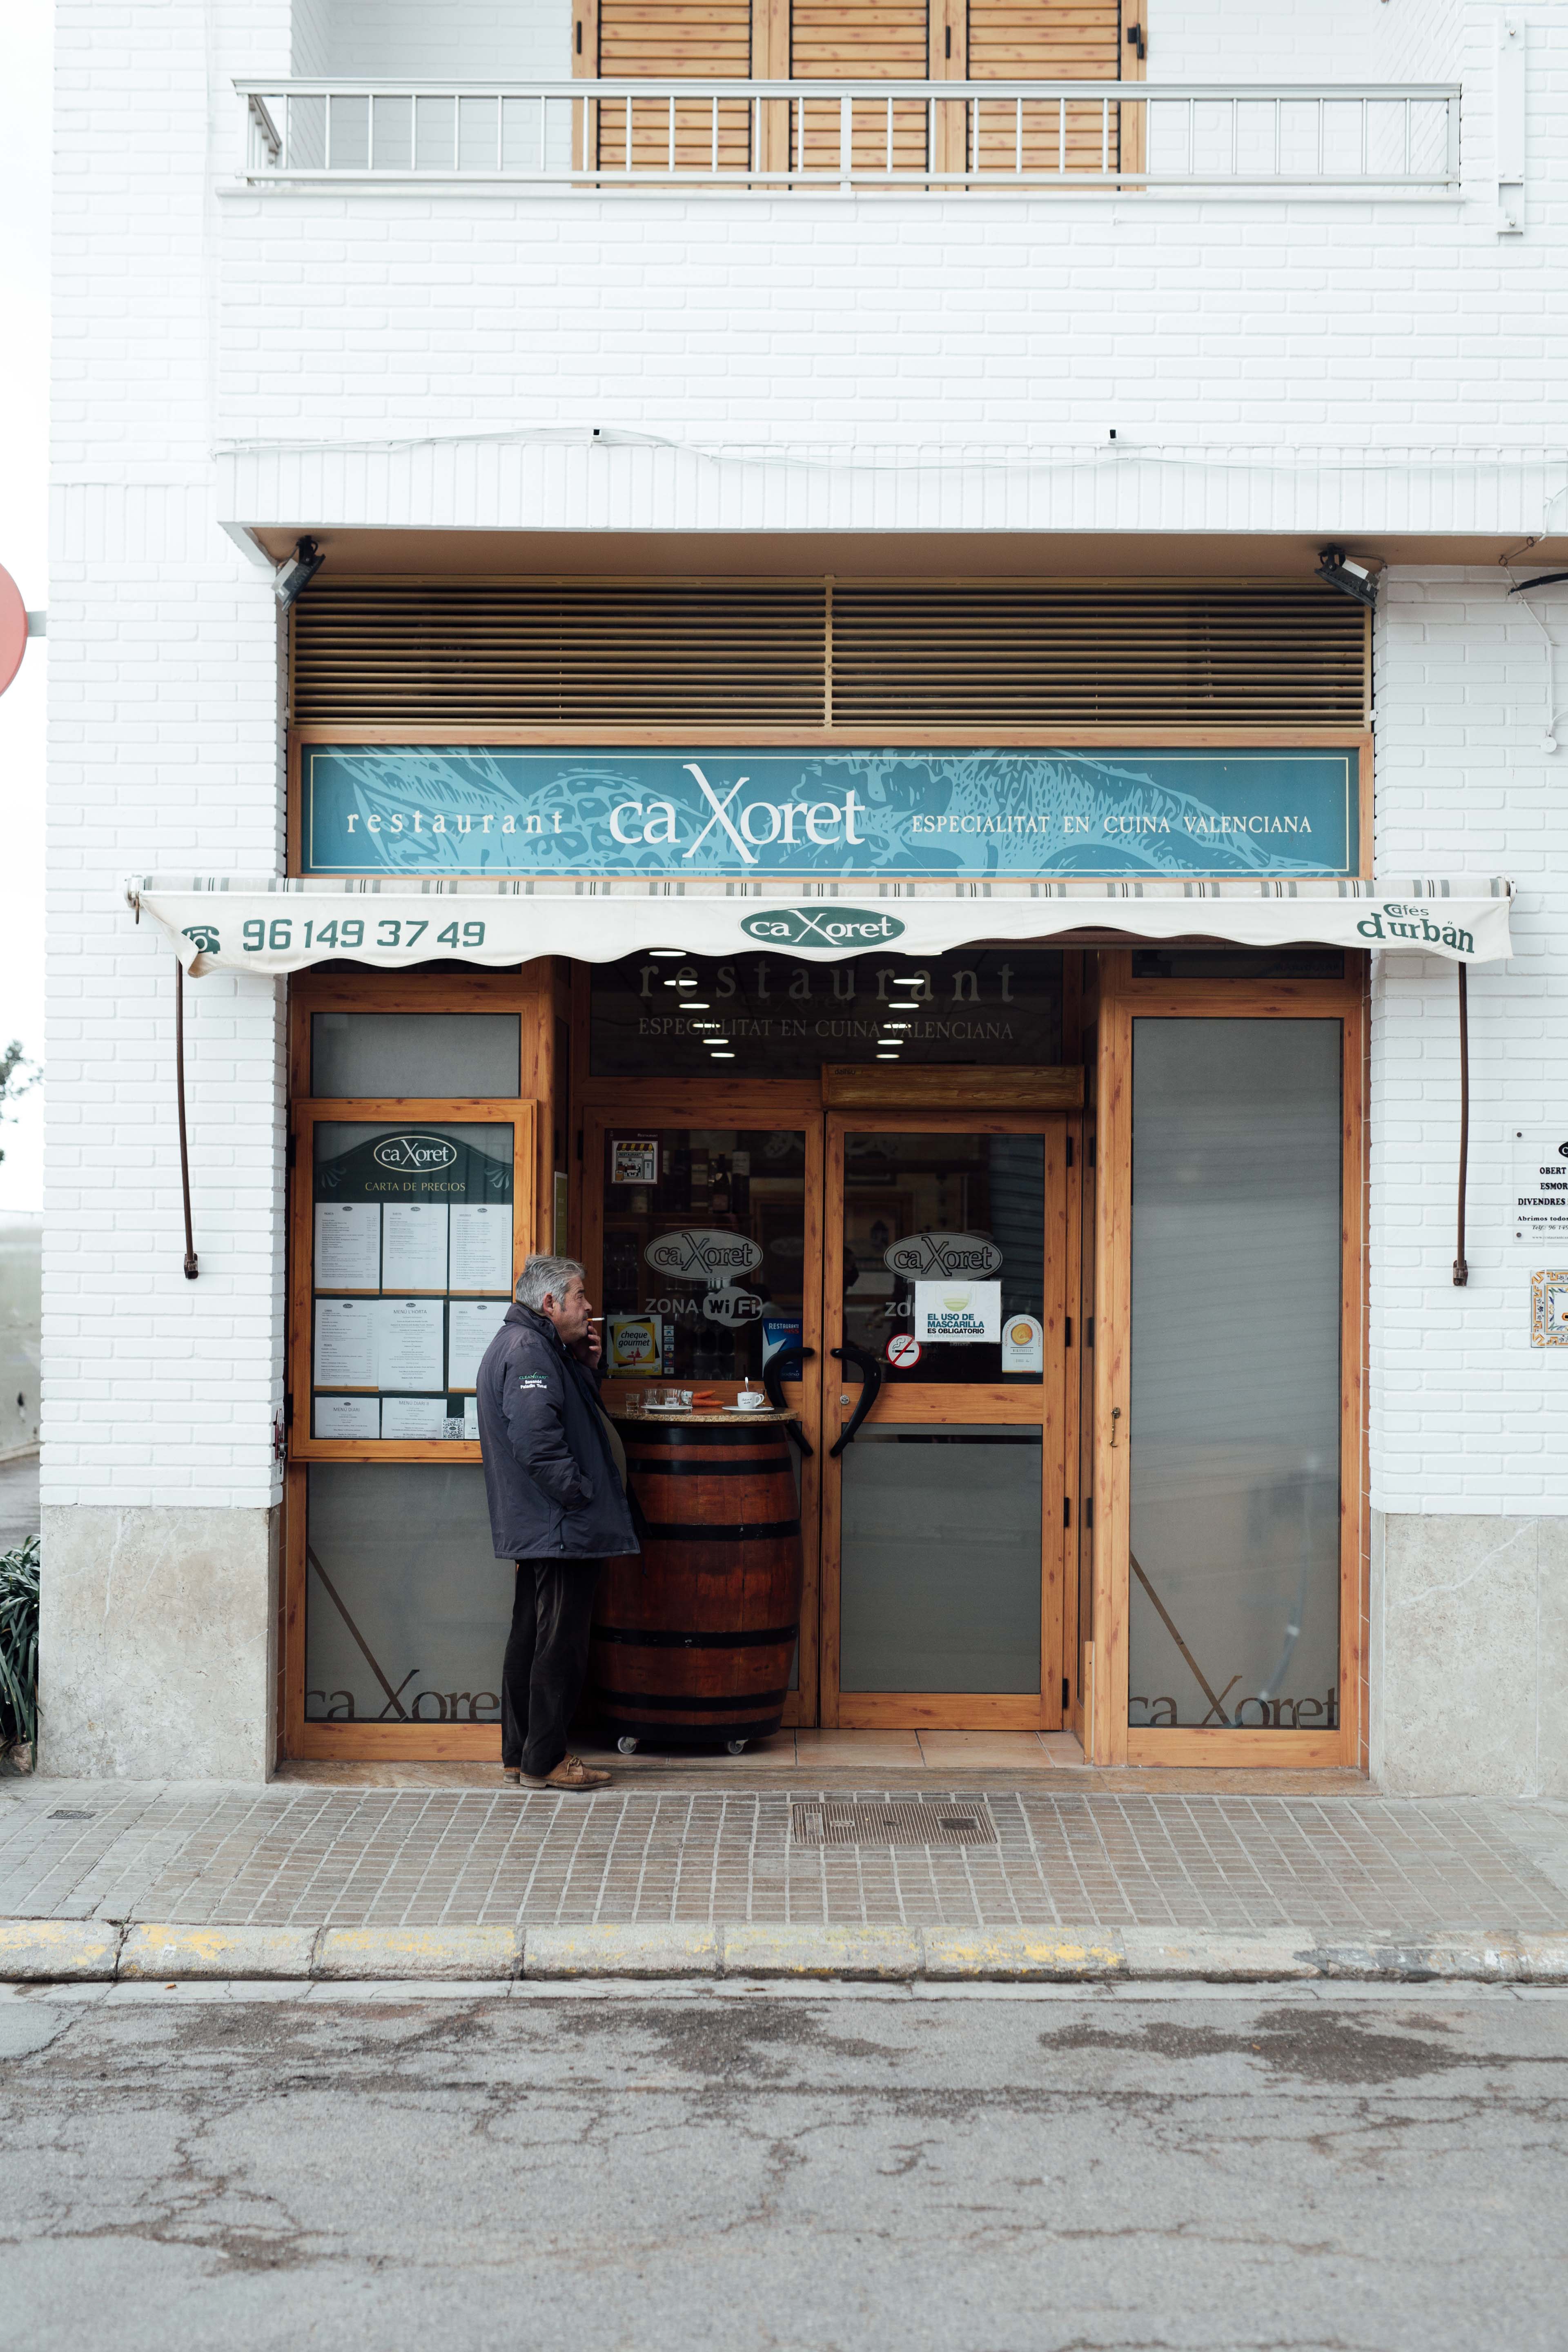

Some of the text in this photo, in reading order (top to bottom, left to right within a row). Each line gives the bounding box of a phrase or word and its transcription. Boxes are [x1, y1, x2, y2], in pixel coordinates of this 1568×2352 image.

[346, 806, 564, 835] restaurant
[911, 816, 1312, 833] ESPECIALITAT EN CUINA VALENCIANA
[1383, 904, 1430, 918] Cafés
[243, 919, 486, 951] 96 149 37 49
[639, 960, 1014, 1002] restaurant
[639, 1018, 1014, 1040] ESPECIALITAT EN CUINA VALENCIANA
[365, 1182, 466, 1192] CARTA DE PRECIOS
[644, 1298, 699, 1314] ZONA
[618, 1339, 650, 1348] gourmet
[621, 1331, 648, 1340] cheque
